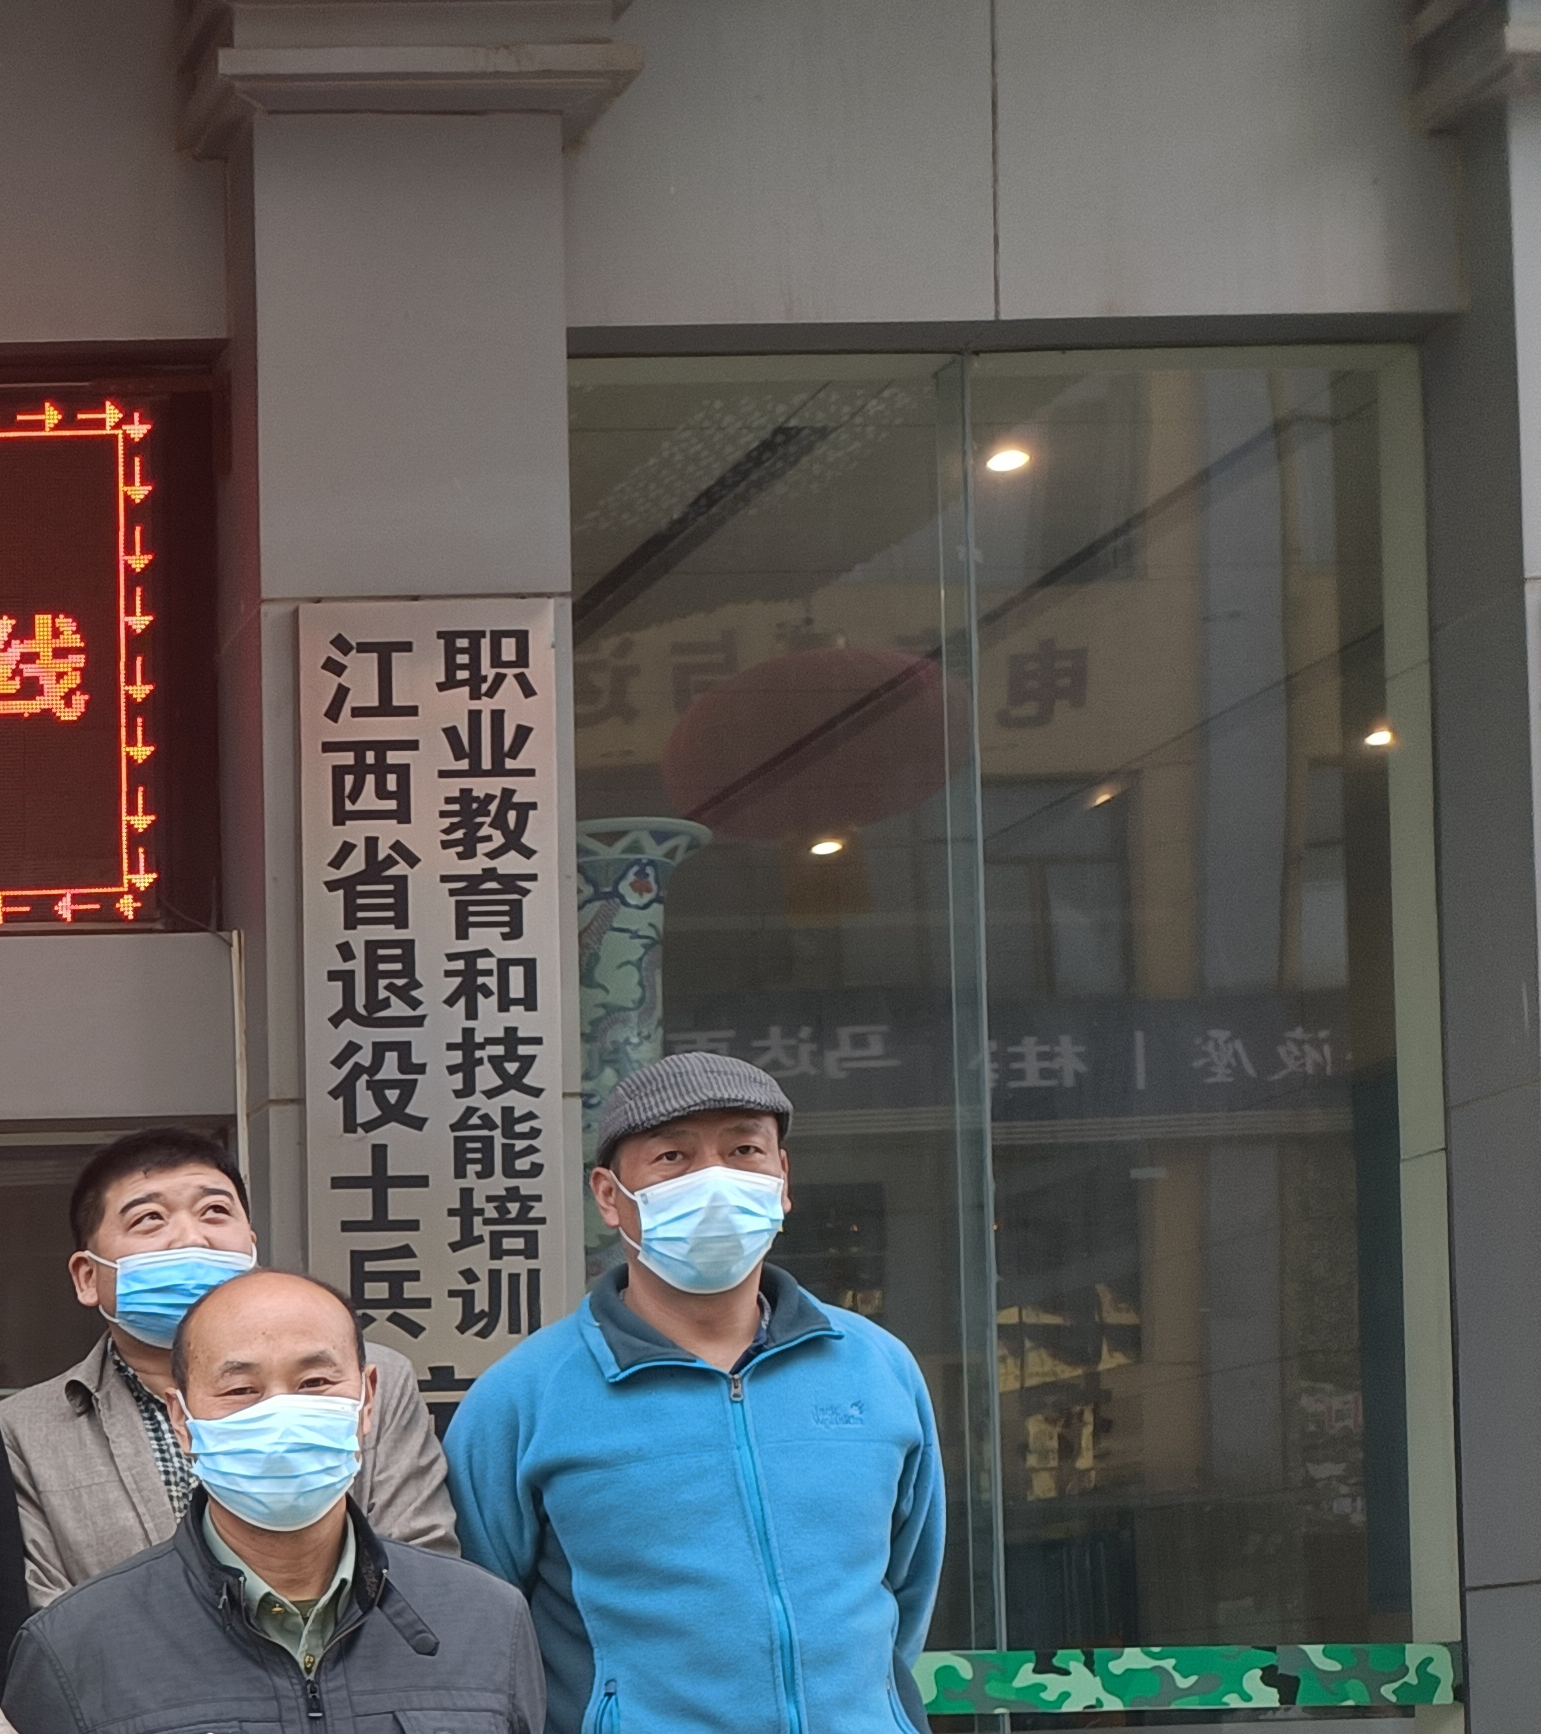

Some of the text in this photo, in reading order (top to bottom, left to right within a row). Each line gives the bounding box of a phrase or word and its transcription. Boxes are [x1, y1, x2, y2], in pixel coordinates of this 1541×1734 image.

[321, 632, 432, 1342] 江西省退役士兵
[436, 628, 547, 1342] 职业教育和技能培训
